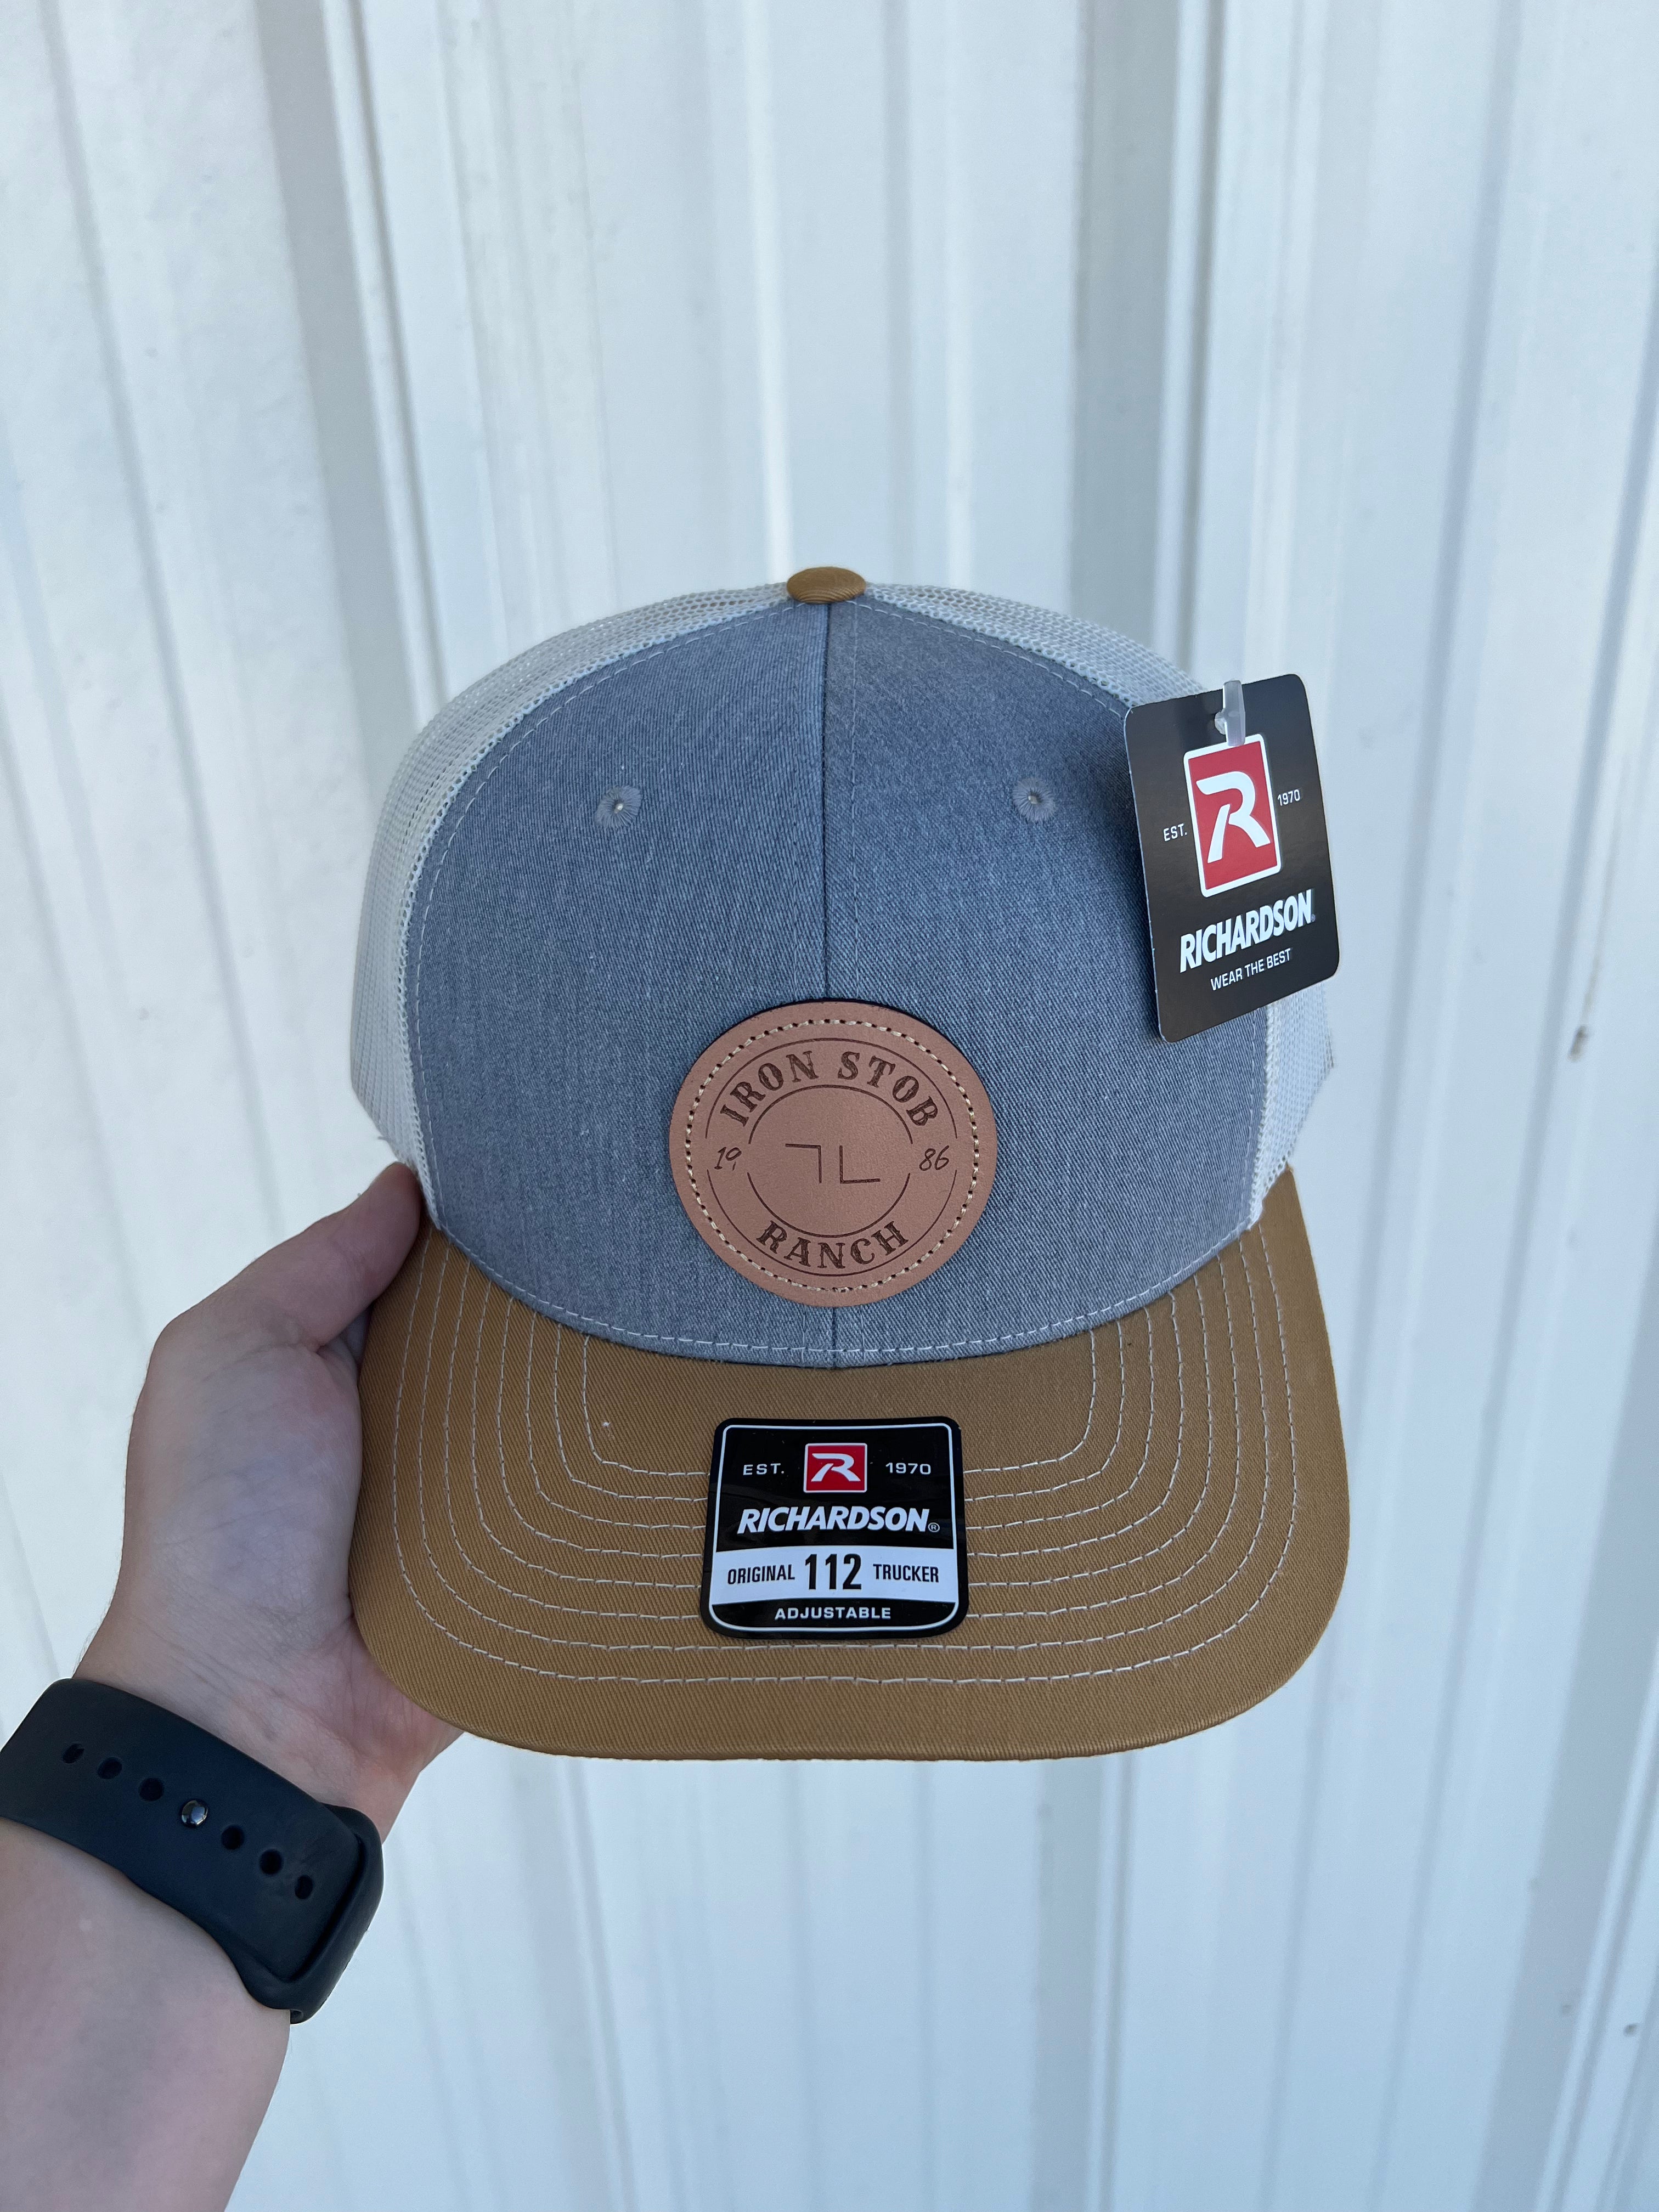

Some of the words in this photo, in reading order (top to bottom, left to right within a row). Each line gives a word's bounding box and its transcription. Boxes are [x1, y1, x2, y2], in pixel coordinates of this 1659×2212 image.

[1163, 823, 1188, 842] EST.
[1277, 788, 1301, 806] 1970
[1210, 969, 1243, 991] WEAR
[1244, 962, 1265, 978] THE
[1266, 947, 1291, 972] BEST
[720, 1050, 819, 1127] IRON
[837, 1051, 939, 1127] STOB
[714, 1147, 742, 1171] 19
[919, 1145, 950, 1171] 86
[756, 1220, 909, 1269] RANCH
[742, 1463, 785, 1476] EST.
[885, 1462, 932, 1475] 1970
[727, 1564, 795, 1585] ORIGINAL
[804, 1553, 862, 1590] 112
[873, 1563, 939, 1583] TRUCKER
[774, 1607, 891, 1620] ADJUSTABLE
